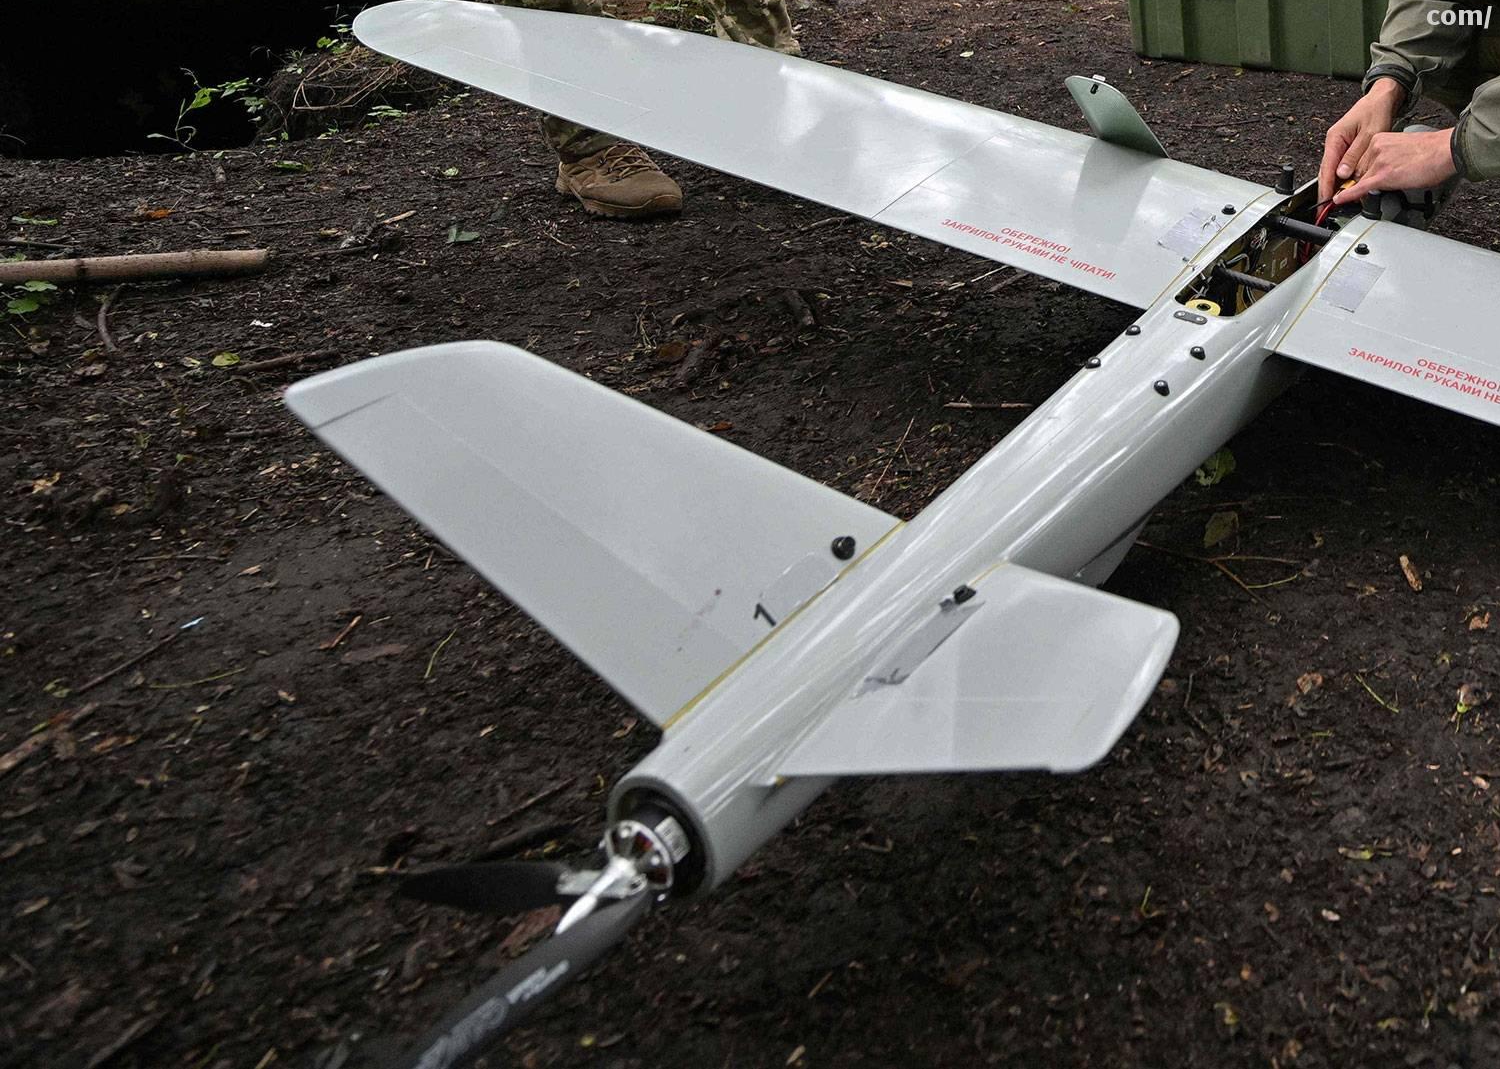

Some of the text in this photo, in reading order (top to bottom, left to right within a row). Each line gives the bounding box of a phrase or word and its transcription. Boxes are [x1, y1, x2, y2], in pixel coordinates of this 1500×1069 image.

[941, 218, 1116, 280] ЗАКРИЛОК РУКАМИ НЕ ЧІПАТИ!
[1001, 227, 1071, 253] ОБЕРЕЖНО!
[1348, 347, 1422, 378] ЗАКРИЛОК
[1424, 372, 1482, 397] РУКАМИ
[753, 602, 777, 627] 1
